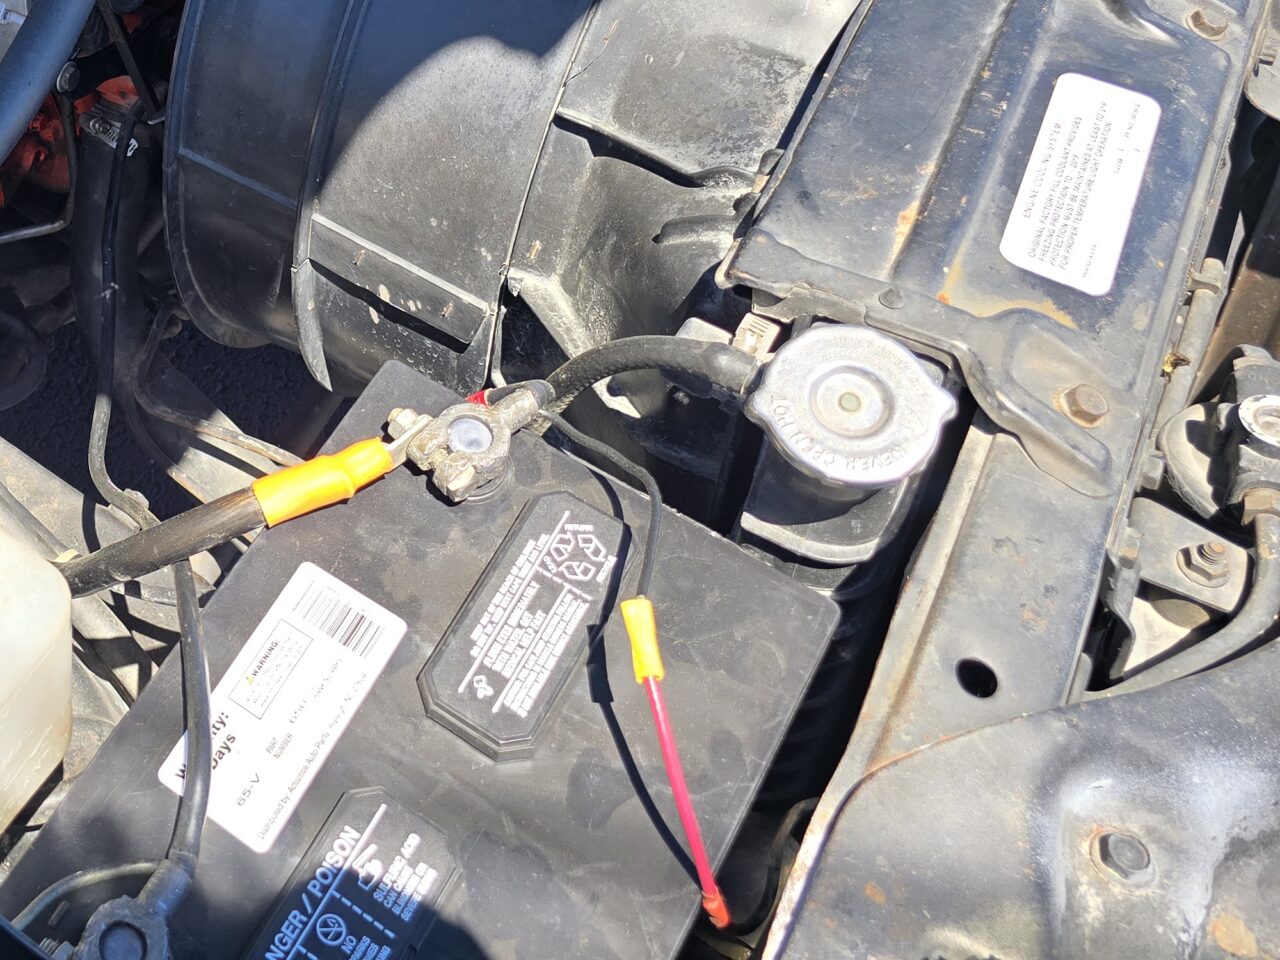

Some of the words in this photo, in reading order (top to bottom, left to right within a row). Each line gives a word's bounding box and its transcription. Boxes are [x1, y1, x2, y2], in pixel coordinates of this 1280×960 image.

[1024, 190, 1039, 218] ENGINE
[1036, 154, 1051, 186] COOLING
[1048, 123, 1061, 150] SYSTEM
[1028, 227, 1044, 257] ORIGINAL
[1040, 194, 1054, 224] FACTORY
[1050, 180, 1060, 192] FILL
[1056, 148, 1069, 177] COOLANT
[1067, 117, 1082, 146] PROVIDES
[1050, 223, 1067, 265] PROTECTION
[1063, 203, 1073, 220] MUST
[1069, 194, 1077, 202] BE
[1073, 153, 1091, 191] MAINTAINED
[1086, 143, 1093, 152] AT
[1090, 123, 1100, 142] LEAST
[1095, 113, 1104, 122] TO
[1058, 255, 1069, 270] FOR
[1064, 226, 1078, 254] PROPER
[1073, 179, 1094, 223] TEMPERATURE
[1090, 158, 1099, 177] LIGHT
[1095, 123, 1111, 157] OPERATION
[1039, 229, 1055, 261] FREEZING
[1050, 186, 1068, 226] PROTECTION
[770, 395, 794, 428] HOT
[793, 431, 836, 466] OPEN
[848, 444, 908, 471] NEVER
[483, 642, 501, 665] FLUSH
[496, 625, 512, 644] EYES
[508, 581, 538, 626] IMMEDIATELY
[492, 652, 509, 671] WITH
[520, 611, 533, 627] GET
[501, 646, 525, 677] MEDICAL
[519, 628, 535, 647] HELP
[530, 610, 546, 630] FAST
[252, 642, 278, 676] WARNING:
[266, 737, 277, 753] PART
[273, 734, 292, 759] NUMBER
[238, 773, 259, 806] 65-V
[258, 803, 283, 839] Distributed
[307, 824, 360, 897] POISON
[373, 855, 407, 901] SULFURIC
[401, 833, 420, 858] ACID
[382, 890, 397, 908] CAN
[394, 864, 413, 890] CAUSE
[393, 873, 420, 914] BLINDNESS
[400, 891, 422, 921] SEVERE
[341, 936, 356, 953] NO
